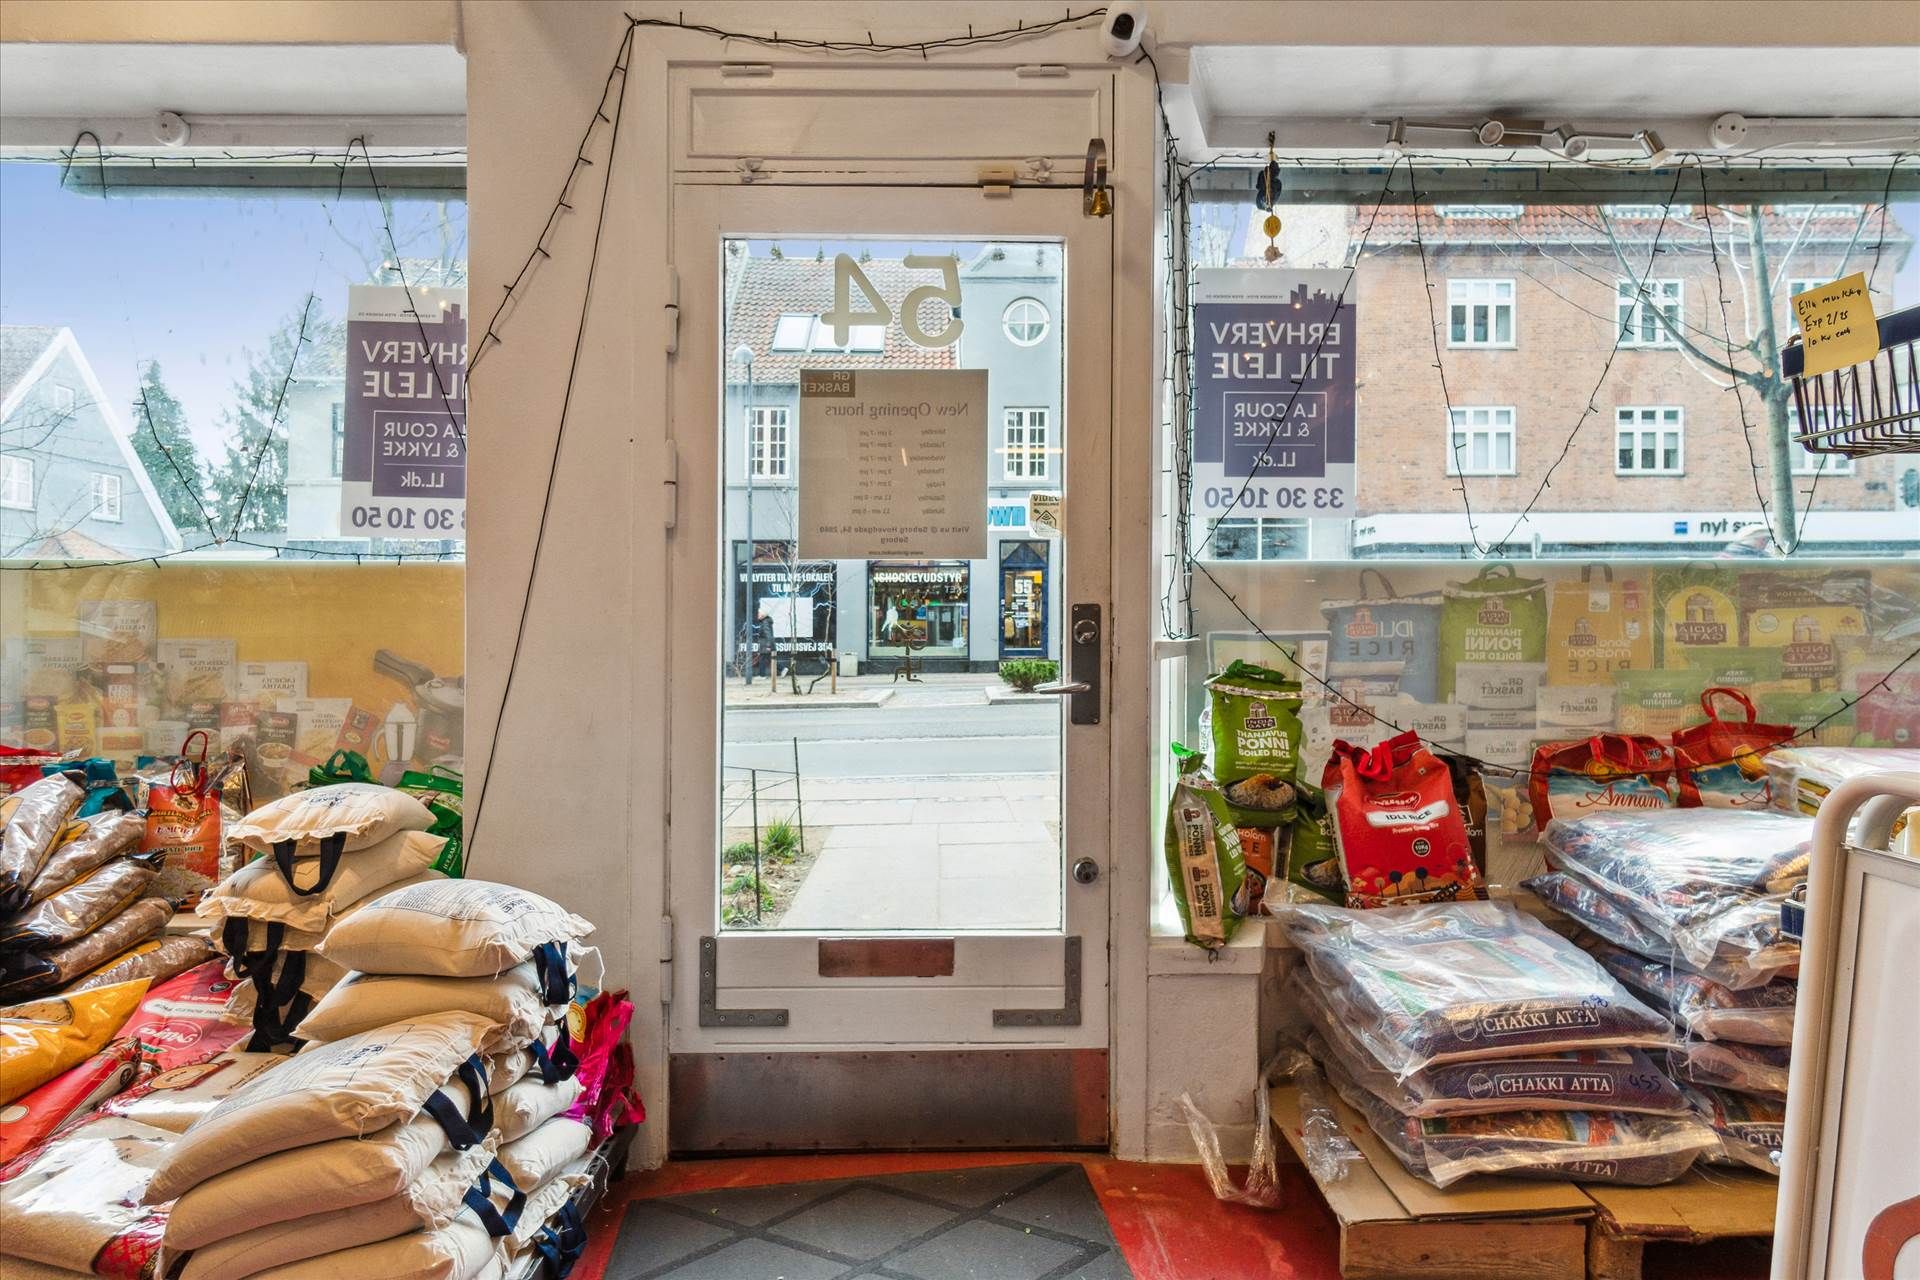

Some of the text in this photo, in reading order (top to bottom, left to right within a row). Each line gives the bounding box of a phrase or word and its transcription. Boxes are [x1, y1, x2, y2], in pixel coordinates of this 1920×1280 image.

[1803, 315, 1823, 332] Exp
[1700, 518, 1729, 537] nyt
[752, 573, 777, 582] LYTTER
[1236, 729, 1288, 739] THANJAVUR
[1237, 736, 1290, 750] PONNI
[1238, 748, 1291, 758] BOILED RICE
[1575, 782, 1664, 809] Annam
[1385, 810, 1433, 822] IDLI RICE
[1192, 824, 1202, 857] PONNI
[1200, 883, 1212, 918] PONNI
[1482, 1008, 1597, 1032] CHAKKI ATTA
[1499, 1077, 1611, 1094] CHAKKI ATTA
[1571, 1160, 1612, 1177] ATTA
